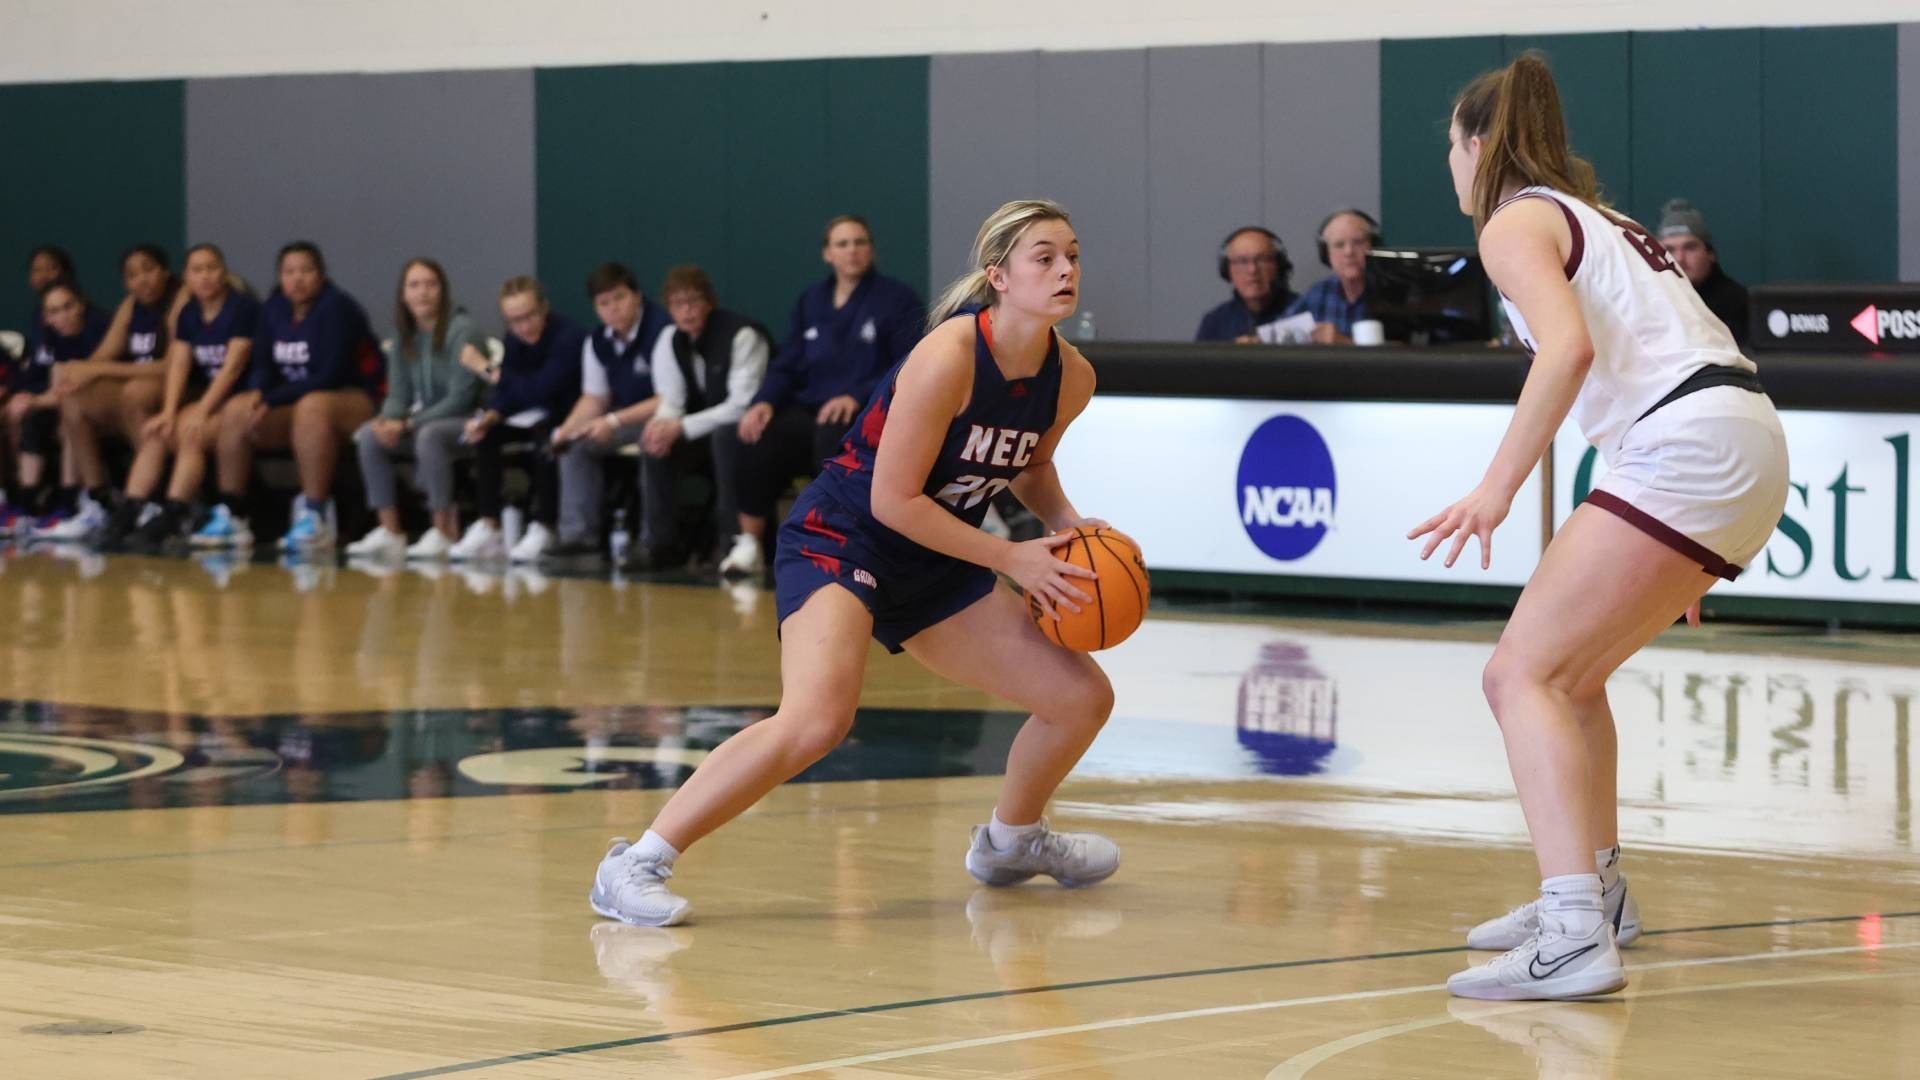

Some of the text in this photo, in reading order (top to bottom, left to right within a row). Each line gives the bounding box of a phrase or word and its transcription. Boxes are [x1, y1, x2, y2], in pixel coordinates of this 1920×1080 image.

[1790, 313, 1829, 333] BONUS
[960, 424, 1039, 467] NEC
[1243, 484, 1333, 528] NCAA
